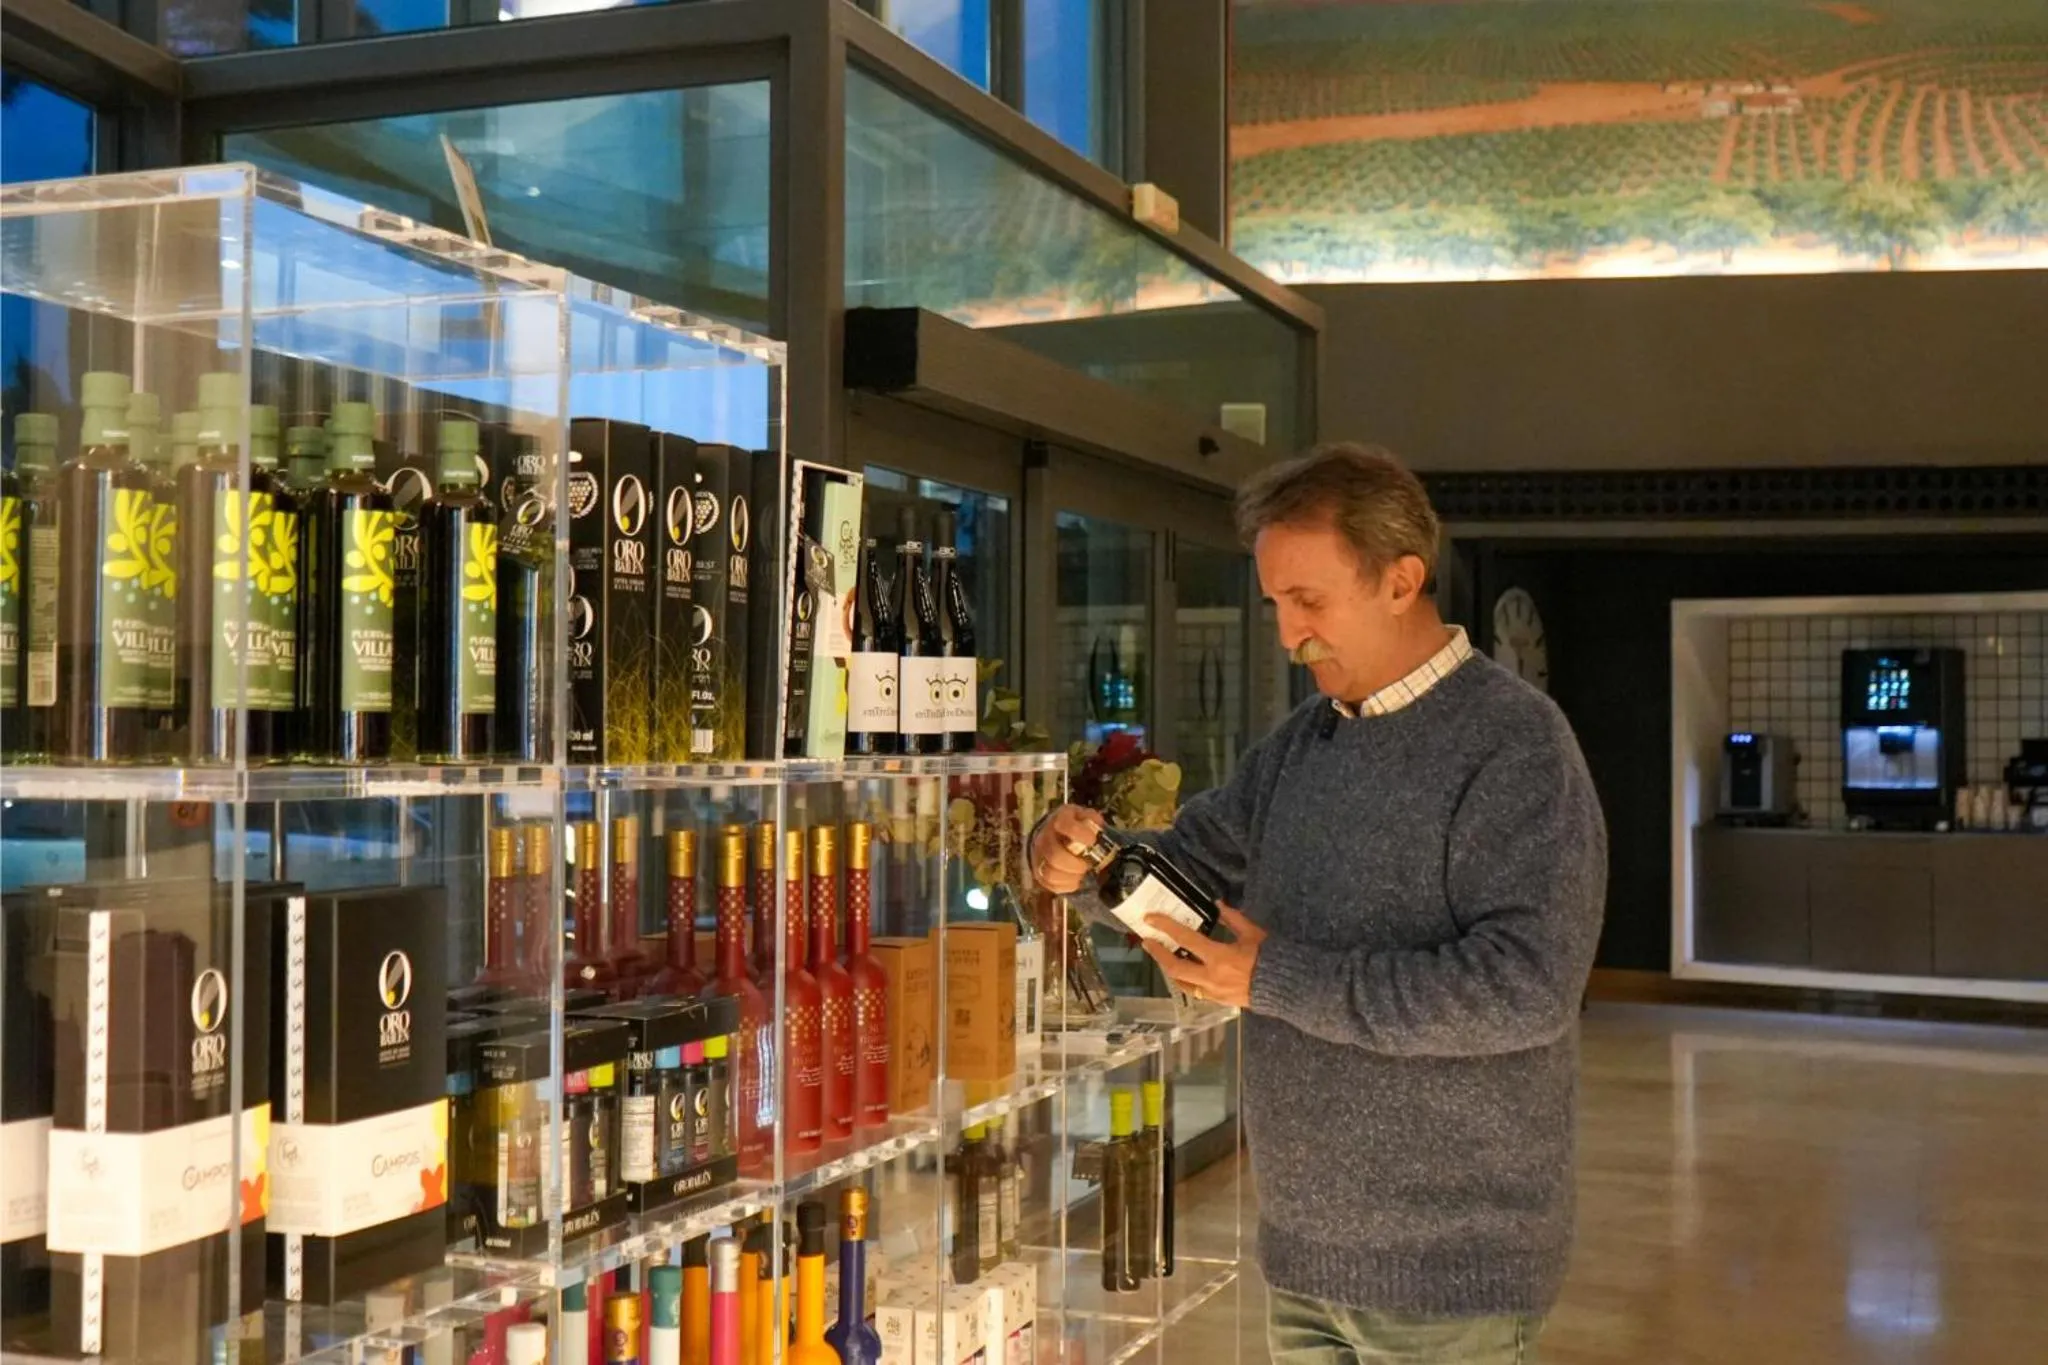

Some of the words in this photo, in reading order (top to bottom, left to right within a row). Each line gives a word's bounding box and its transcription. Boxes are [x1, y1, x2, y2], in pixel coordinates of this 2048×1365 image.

[614, 539, 644, 561] ORO
[667, 549, 691, 570] ORO
[379, 1011, 410, 1033] ORO
[192, 1033, 226, 1058] ORO
